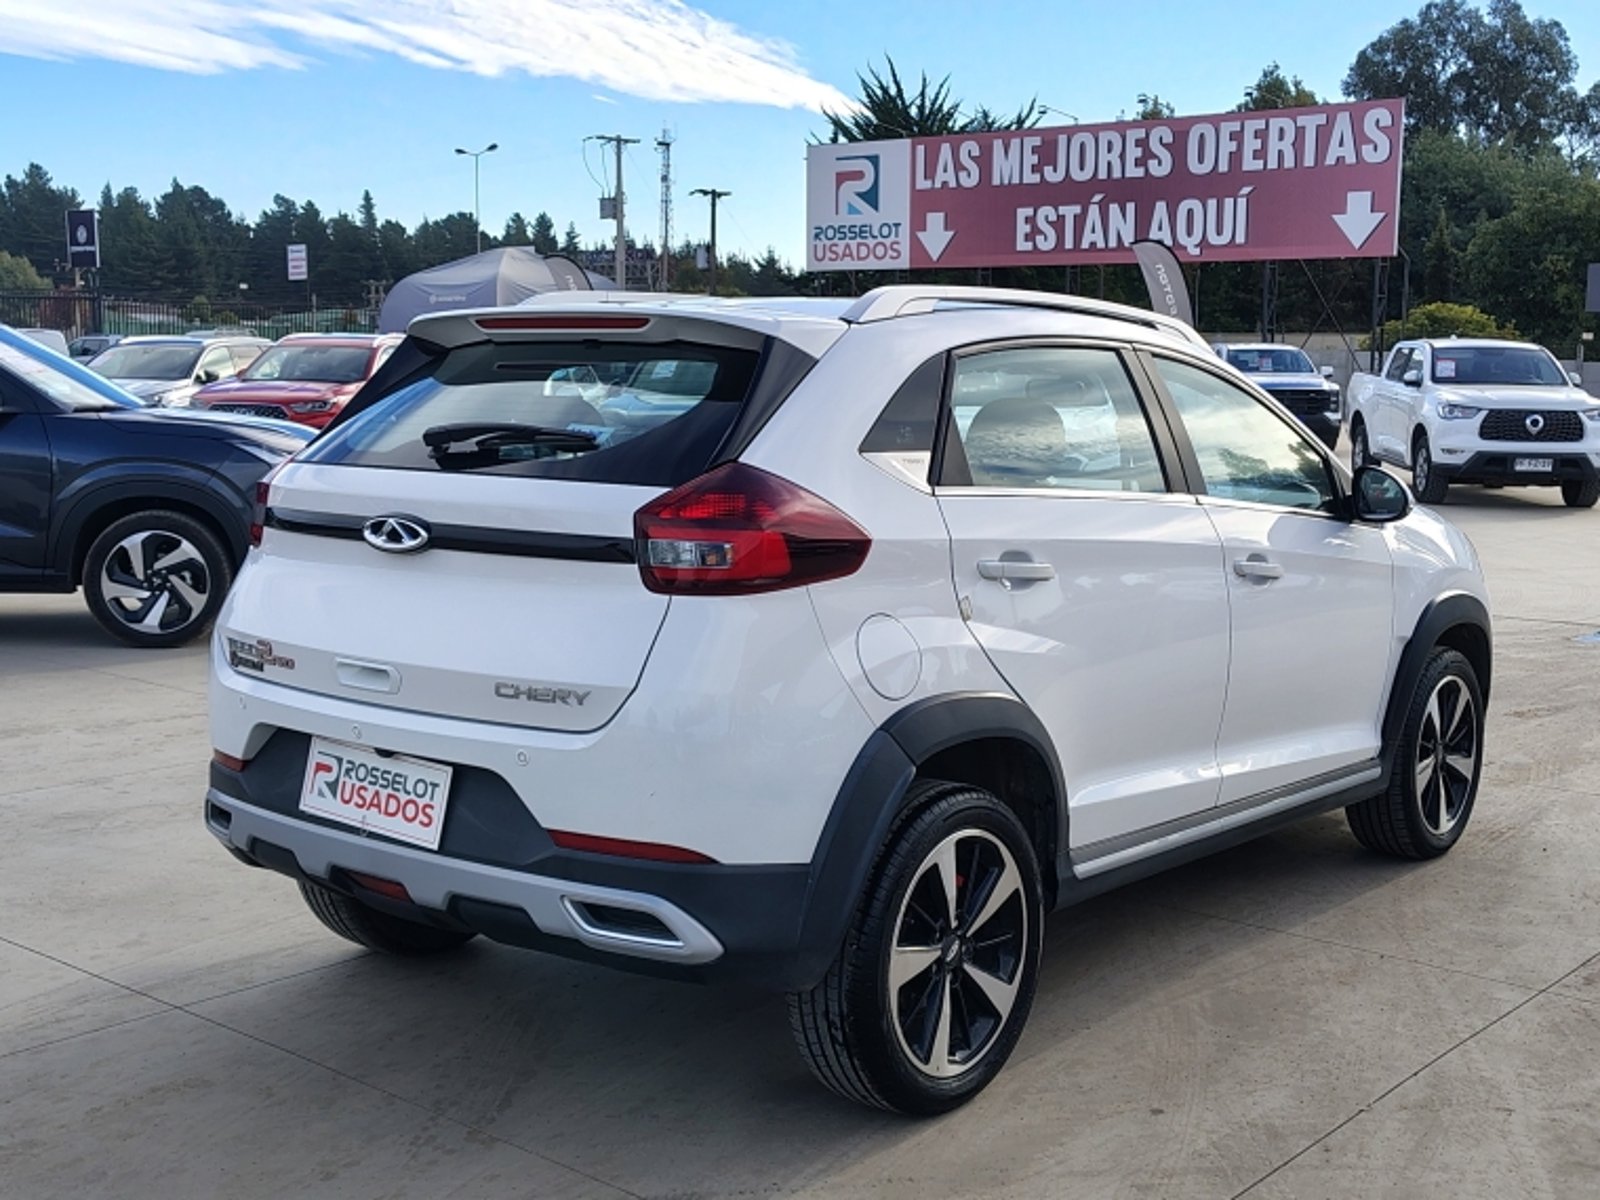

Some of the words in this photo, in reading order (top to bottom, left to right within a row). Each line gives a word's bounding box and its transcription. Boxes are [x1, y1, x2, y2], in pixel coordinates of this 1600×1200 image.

[915, 140, 980, 190] LAS
[991, 126, 1174, 187] MEJORES
[1186, 107, 1393, 175] OFERTAS
[813, 222, 902, 241] ROSSELOT
[1016, 193, 1136, 252] ESTÁN
[1148, 185, 1256, 256] AQUÍ
[813, 241, 902, 262] USADOS
[494, 681, 592, 707] CHERY
[343, 759, 440, 801] ROSSELOT
[340, 781, 435, 828] USADOS
